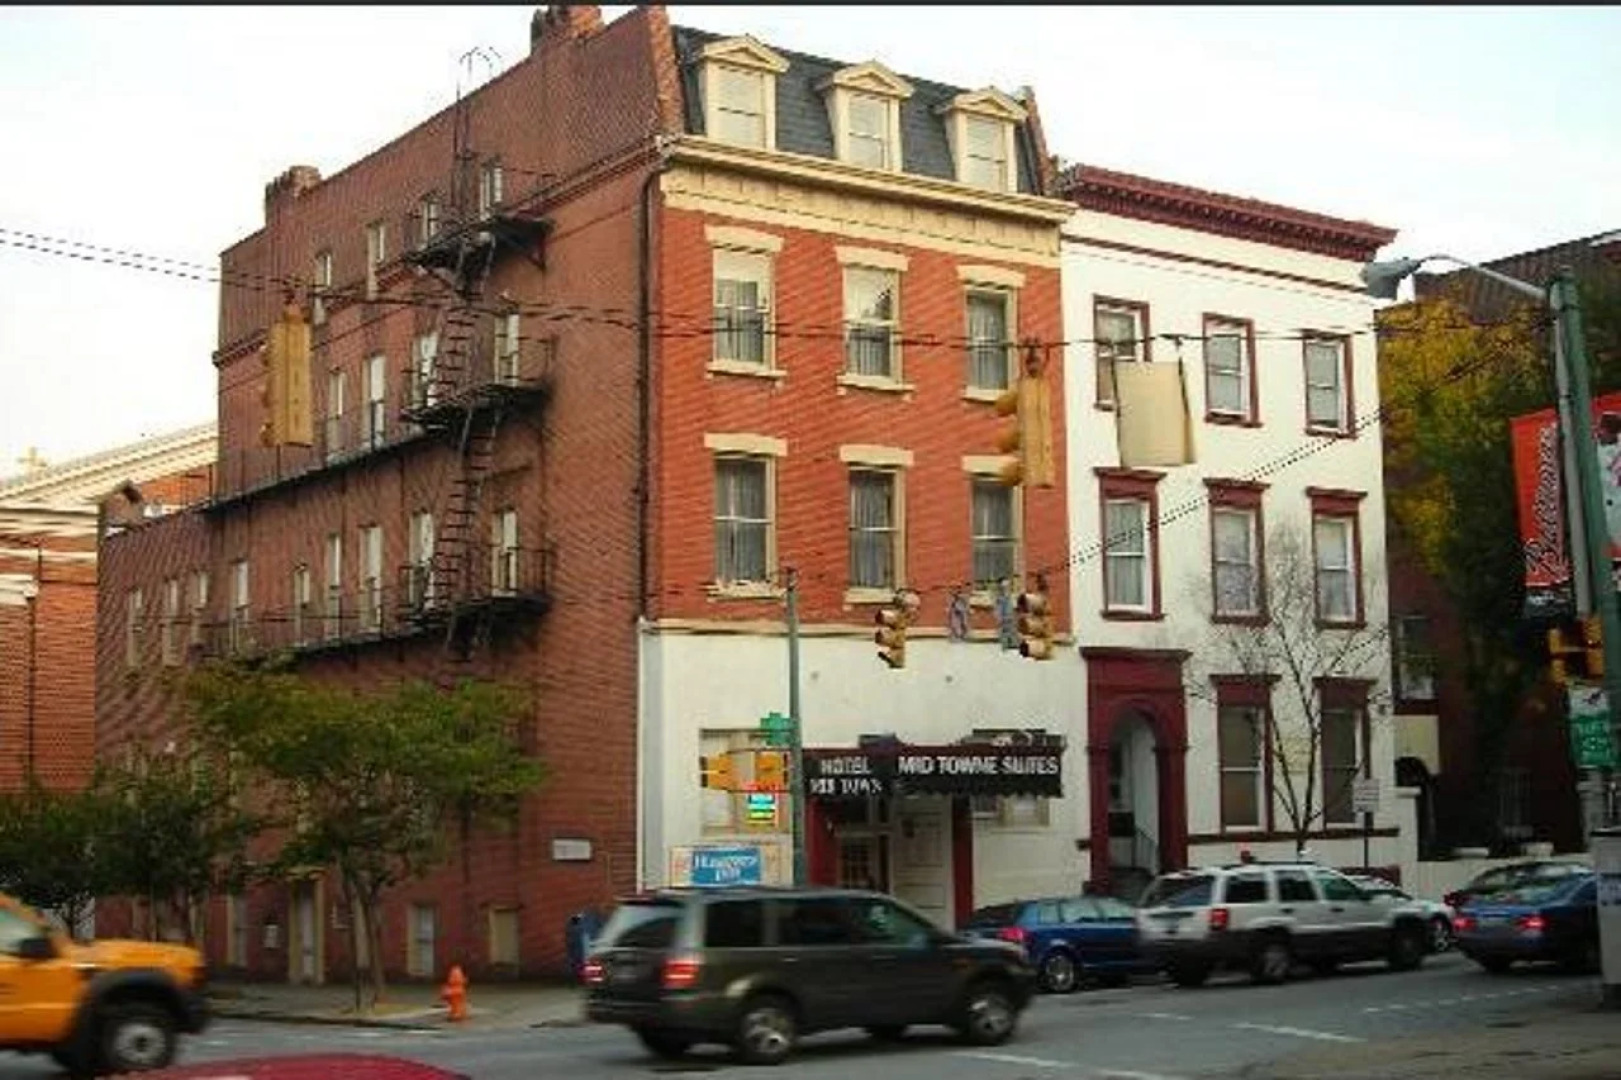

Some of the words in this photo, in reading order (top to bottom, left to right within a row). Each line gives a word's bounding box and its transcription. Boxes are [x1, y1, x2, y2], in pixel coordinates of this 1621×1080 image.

[820, 756, 871, 775] HOTEL
[898, 756, 933, 775] MID
[936, 756, 998, 775] TOWNE
[1001, 756, 1059, 775] SUITES
